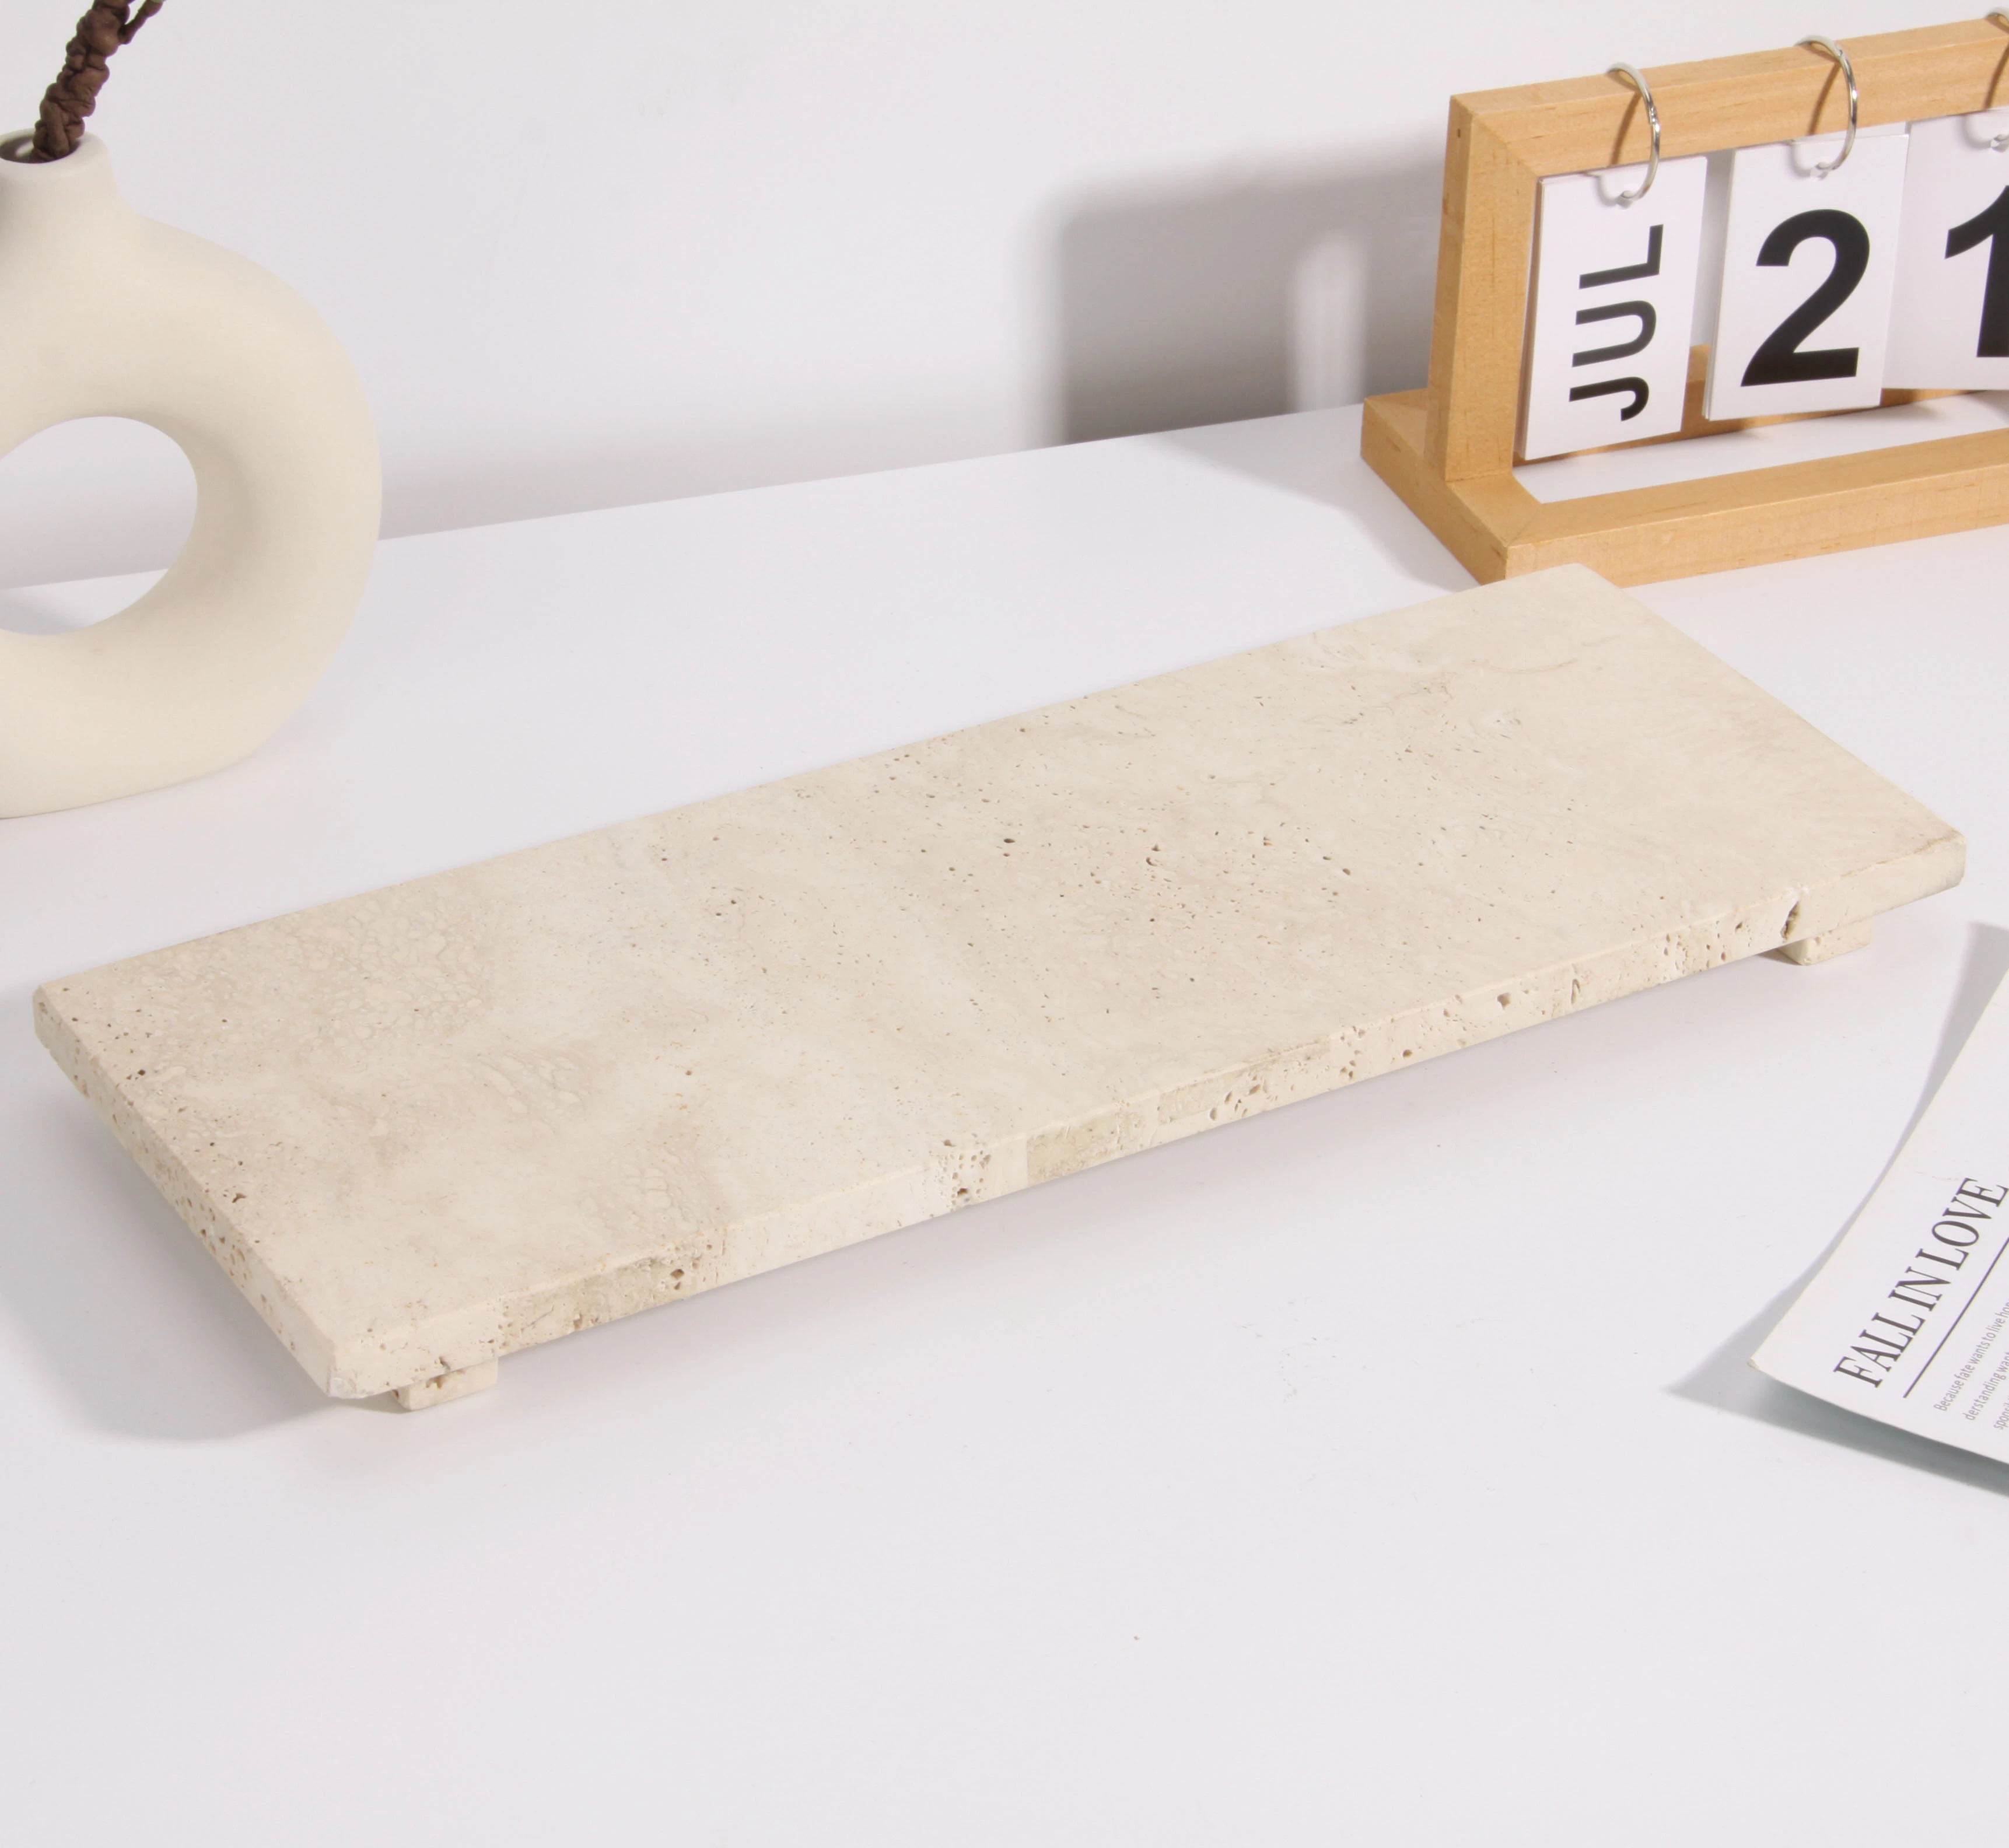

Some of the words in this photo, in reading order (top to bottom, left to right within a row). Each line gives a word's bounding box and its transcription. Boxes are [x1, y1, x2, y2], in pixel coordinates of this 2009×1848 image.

[1740, 209, 1870, 387] 2
[1569, 224, 1664, 421] JUL
[1915, 1177, 2009, 1271] LOVE
[1888, 1266, 1952, 1312] IN
[1981, 1332, 1996, 1342] to
[1985, 1318, 2006, 1333] live
[1833, 1312, 1926, 1388] FALL
[1954, 1364, 1975, 1381] fate
[1968, 1341, 1990, 1364] wants
[1933, 1380, 1965, 1412] Because
[1962, 1372, 2007, 1421] derstanding
